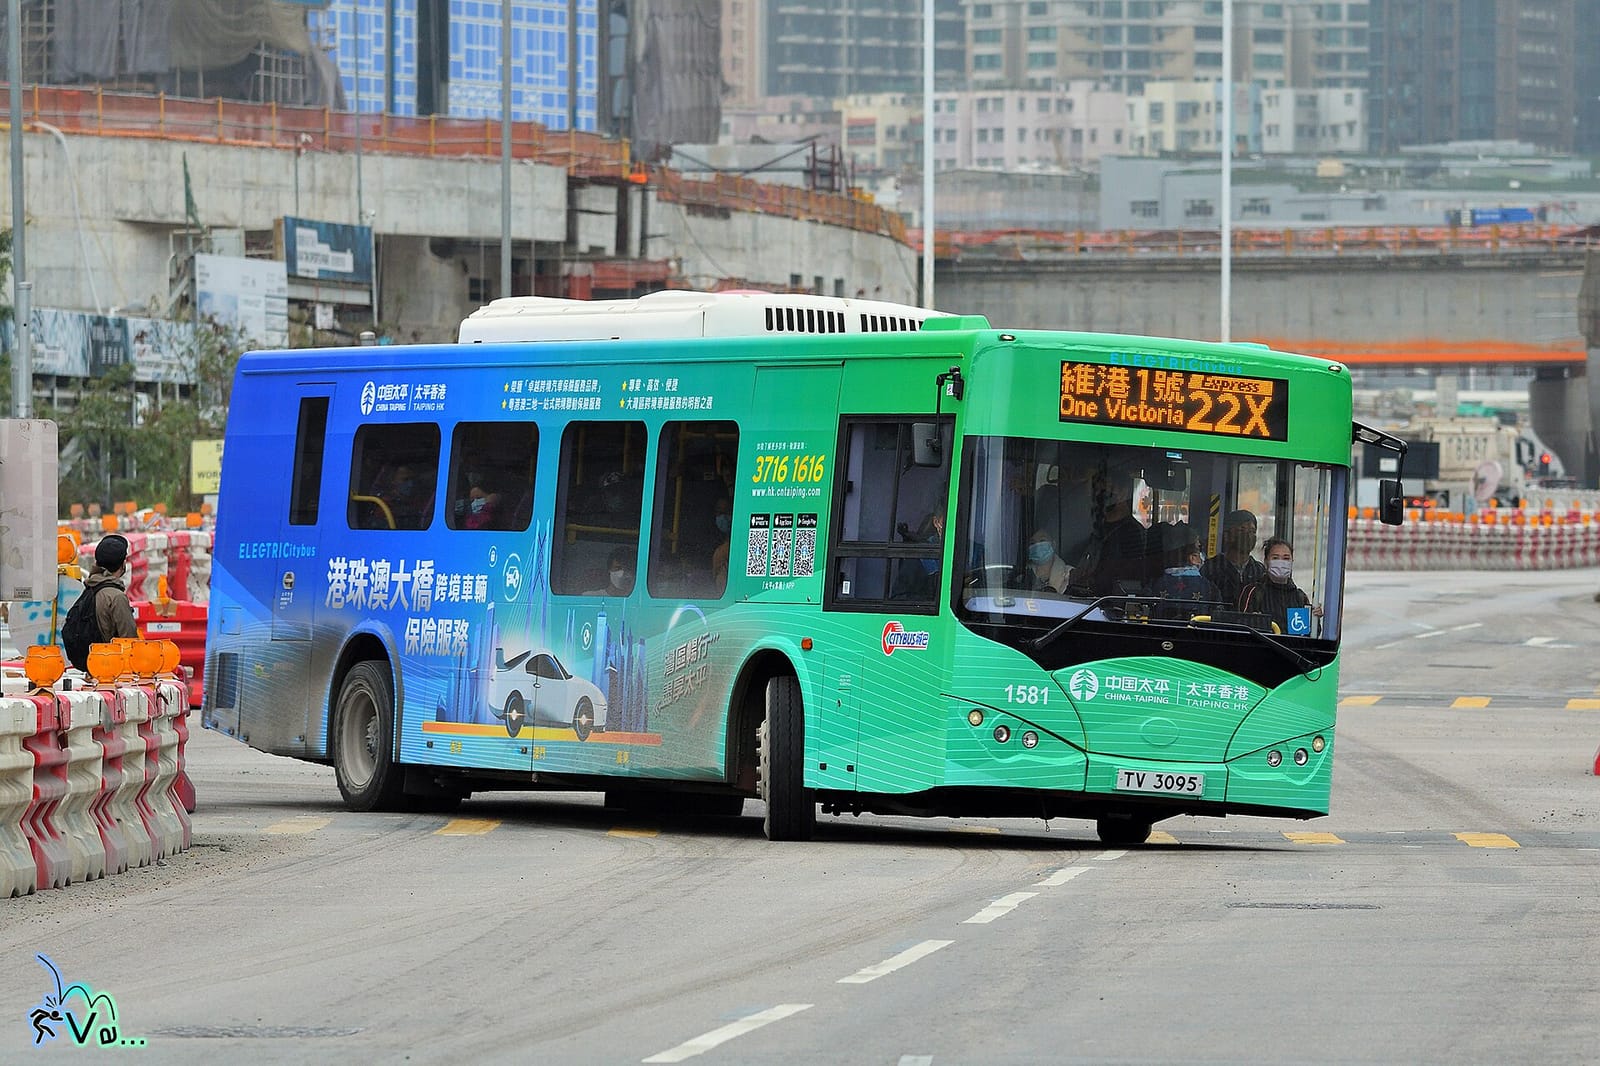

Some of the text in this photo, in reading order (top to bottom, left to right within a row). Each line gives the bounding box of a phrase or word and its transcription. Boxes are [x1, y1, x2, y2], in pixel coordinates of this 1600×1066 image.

[414, 383, 447, 400] 太平香港
[376, 403, 388, 411] CHINA
[413, 402, 435, 411] TAIPING
[436, 402, 445, 411] HK
[1061, 394, 1184, 425] One Victoria
[1186, 391, 1273, 437] 22X
[752, 454, 826, 483] 3716 1616
[751, 487, 821, 499] www.hk.cntaiping.com
[325, 557, 435, 612] 港珠澳大橋
[434, 573, 488, 604] 跨境車輛
[404, 617, 470, 656] 保險服務
[889, 632, 916, 645] CITYBUS
[1004, 684, 1049, 705] 1581
[1104, 692, 1249, 711] CHINA TAIPING TAIPING HK
[1186, 682, 1249, 701] 太平香港
[1123, 771, 1198, 791] TV 3095
